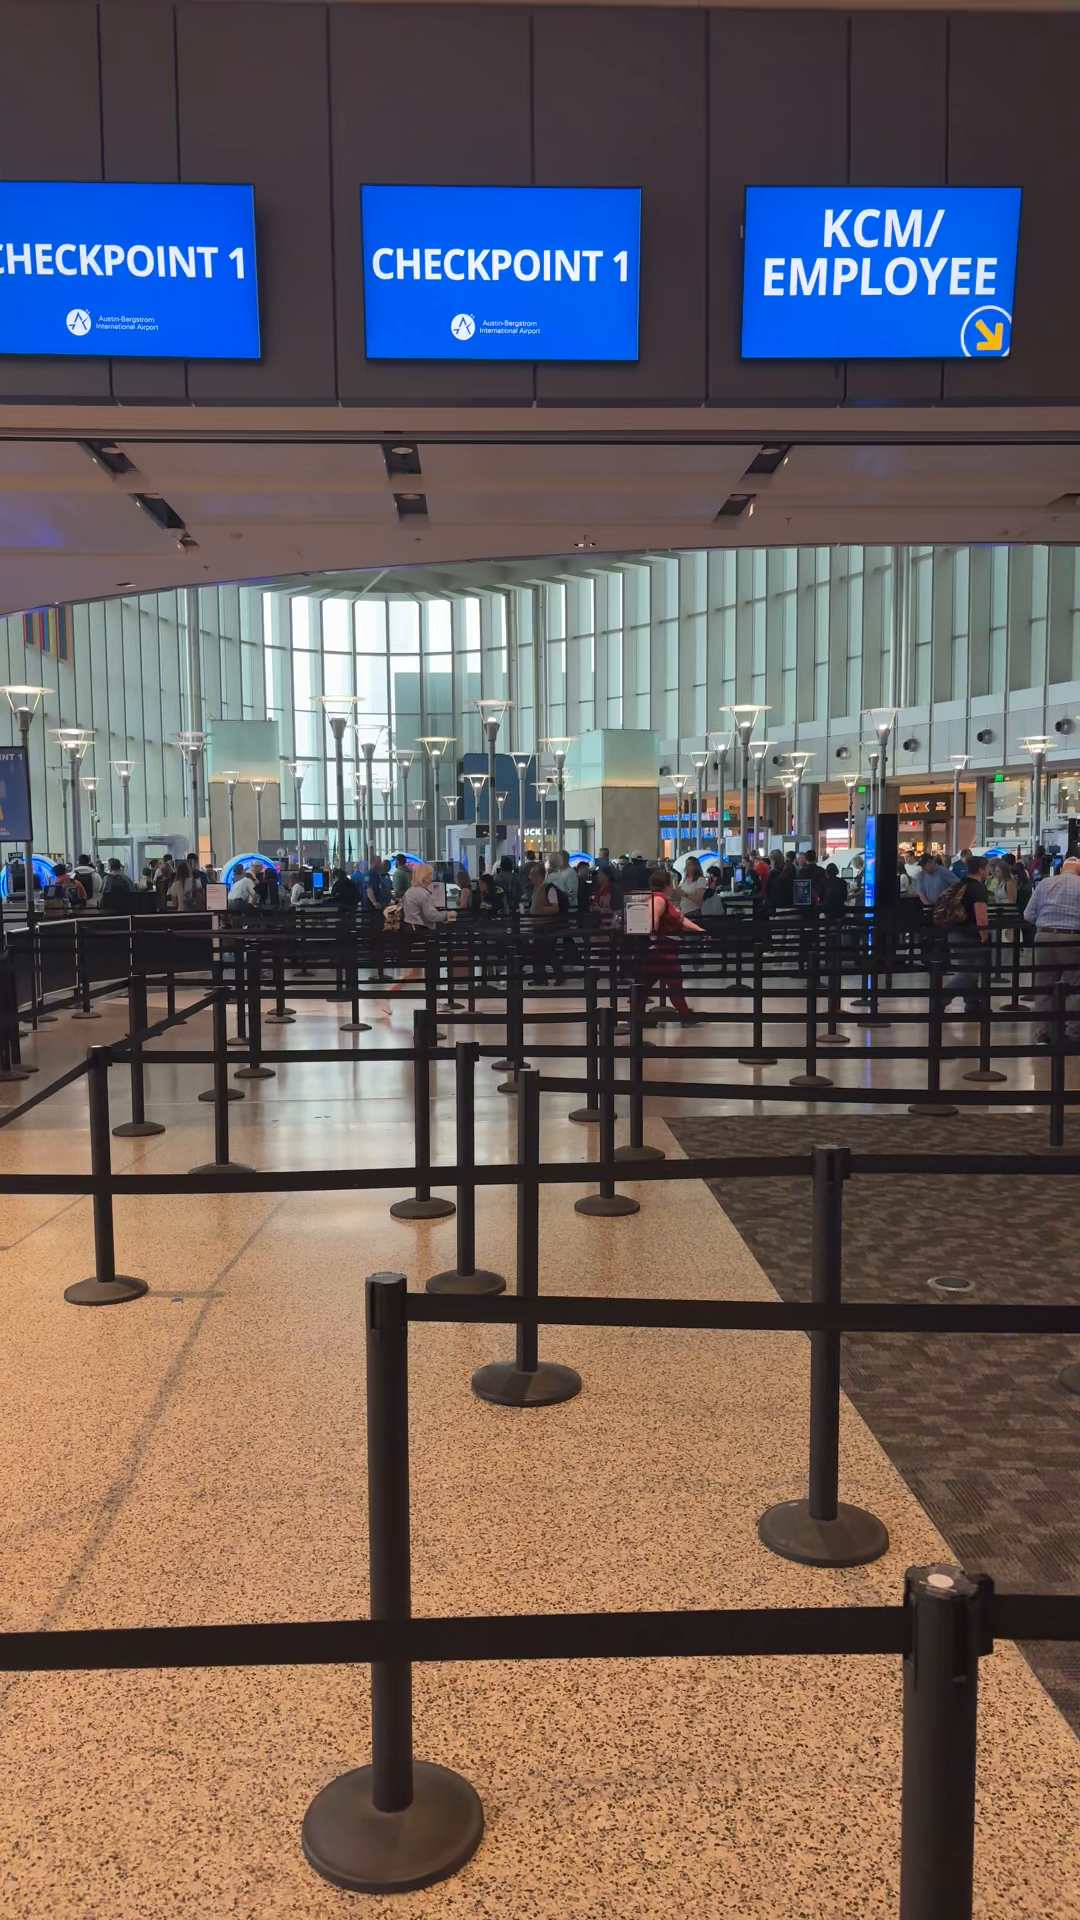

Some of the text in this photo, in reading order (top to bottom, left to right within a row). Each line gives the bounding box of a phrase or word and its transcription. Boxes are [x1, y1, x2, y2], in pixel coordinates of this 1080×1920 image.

[823, 208, 946, 248] KCM/
[0, 243, 245, 279] HECKPOINT 1
[372, 247, 628, 282] CHECKPOINT 1
[763, 256, 998, 297] EMPLOYEE
[95, 323, 159, 332] International Airport
[98, 315, 155, 324] Austin-Bergstrom
[482, 319, 537, 328] Austin-Bergstrom
[479, 327, 541, 336] International Airport
